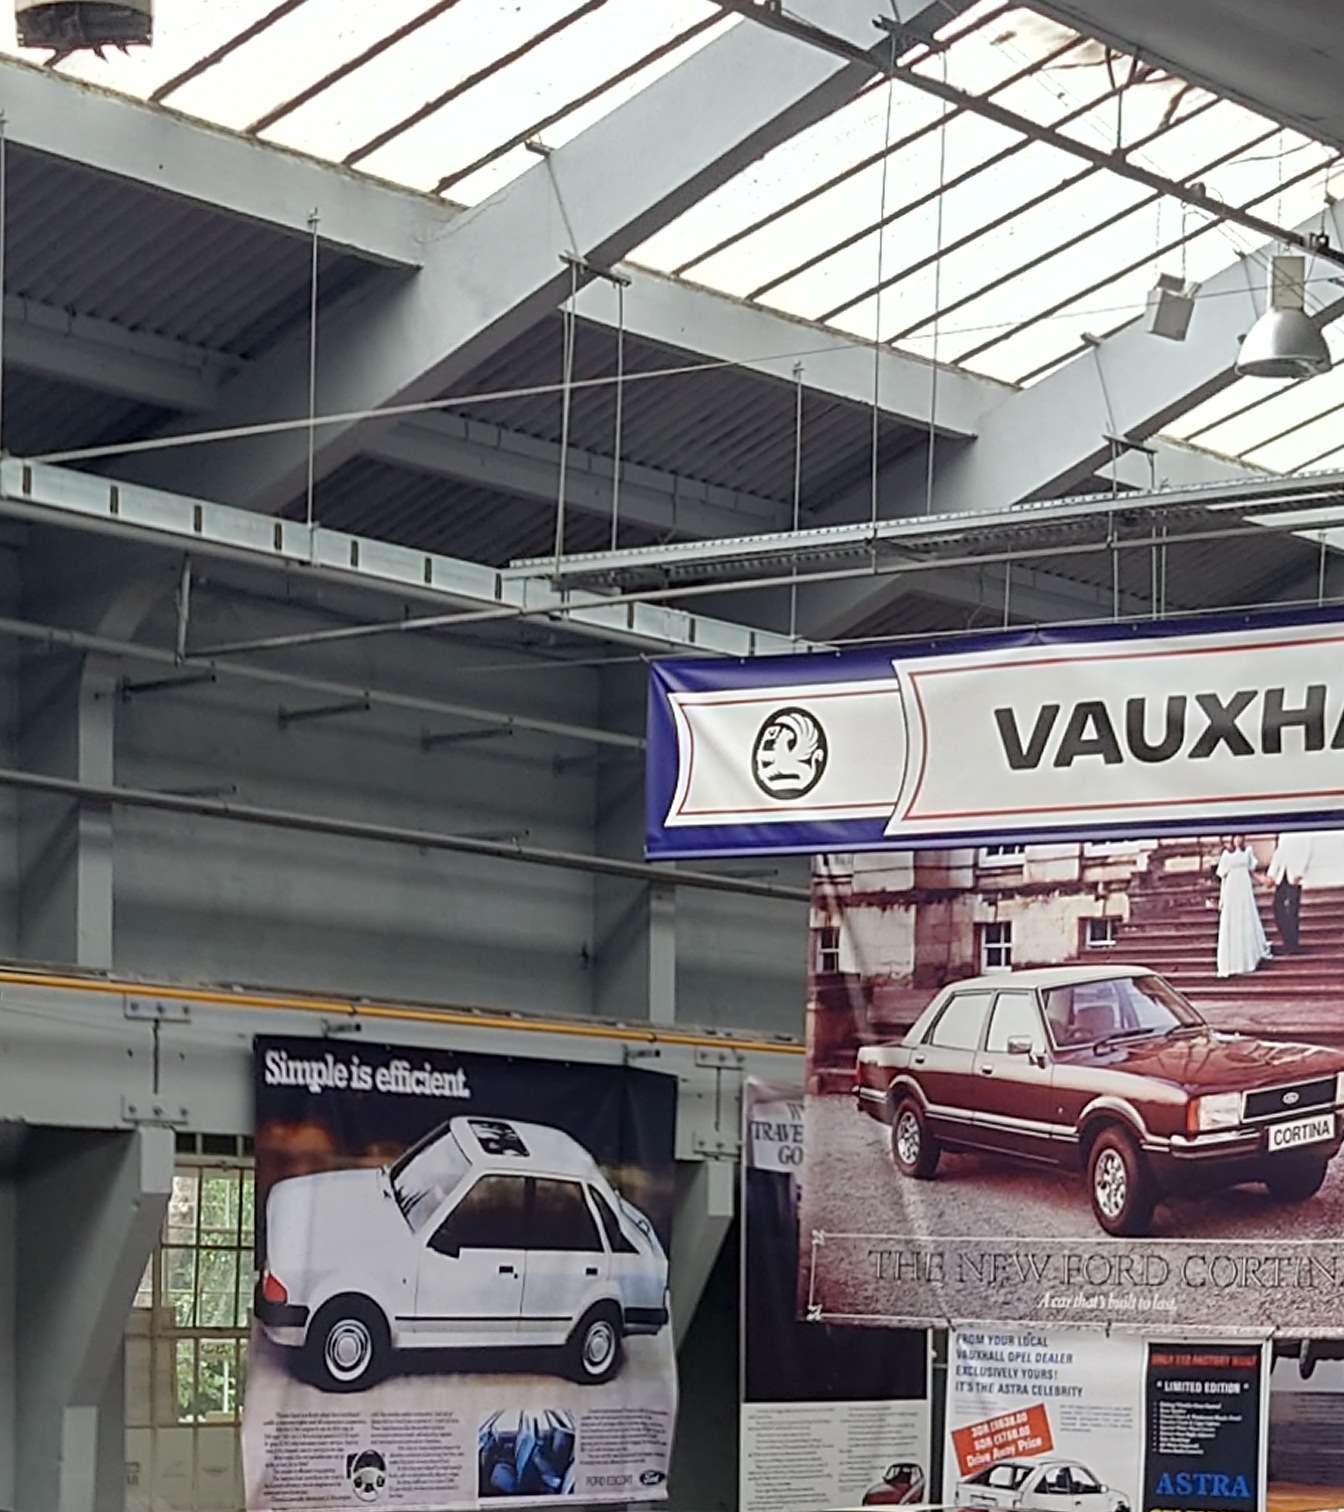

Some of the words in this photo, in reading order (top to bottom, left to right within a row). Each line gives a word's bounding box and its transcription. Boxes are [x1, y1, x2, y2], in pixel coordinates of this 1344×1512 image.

[265, 1050, 349, 1094] Simple
[350, 1060, 373, 1090] is
[375, 1059, 471, 1098] efficient.
[1274, 1120, 1330, 1146] CORTINA
[868, 1250, 944, 1283] THE
[958, 1252, 1053, 1285] NEW
[1060, 1253, 1170, 1287] FORD
[988, 1335, 1015, 1347] YOUR
[1018, 1336, 1048, 1348] LOCAL
[1008, 1351, 1032, 1364] OPEL
[1035, 1352, 1073, 1364] DEALER
[956, 1365, 1018, 1379] EXCLUSIVELY
[975, 1382, 994, 1394] THE
[998, 1383, 1029, 1396] ASTRA
[1031, 1385, 1083, 1398] CELEBRITY
[1157, 1473, 1250, 1498] ASTRA
